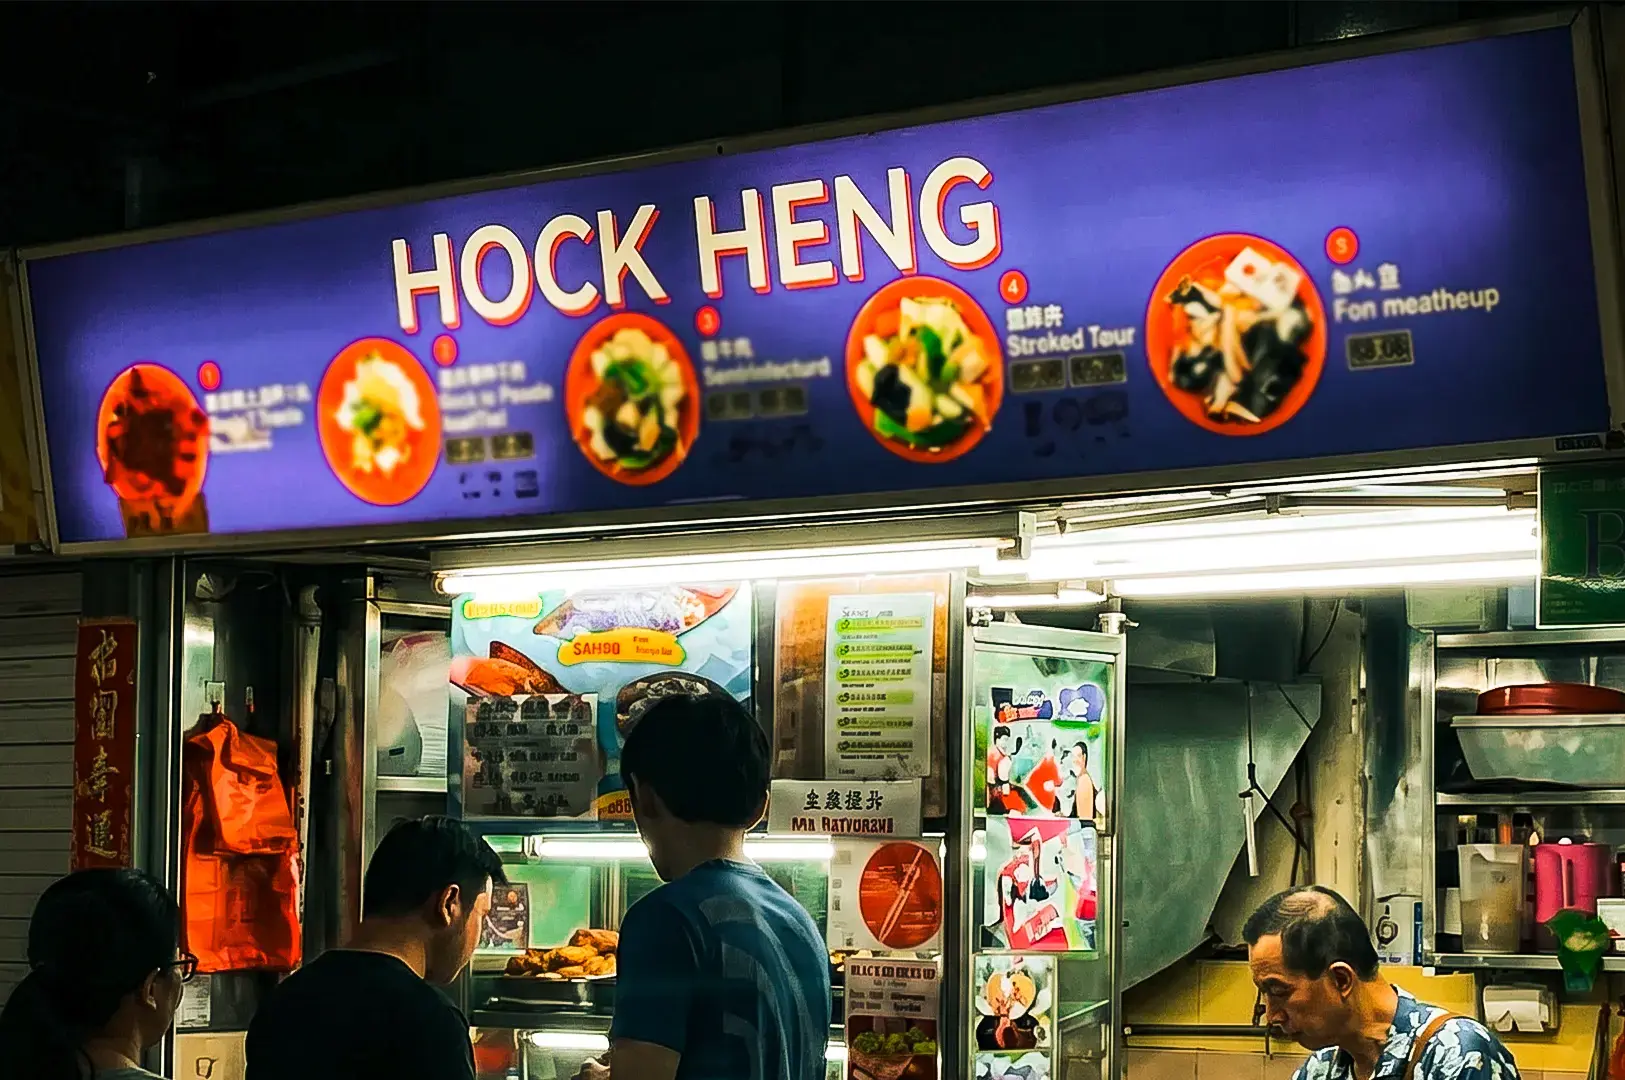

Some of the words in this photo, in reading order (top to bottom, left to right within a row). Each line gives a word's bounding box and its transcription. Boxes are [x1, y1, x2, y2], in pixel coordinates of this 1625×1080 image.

[392, 204, 670, 332] HOCK
[693, 157, 1001, 296] HENG
[1007, 278, 1020, 295] 4
[1333, 297, 1377, 324] Fon
[1383, 287, 1500, 319] meatheup
